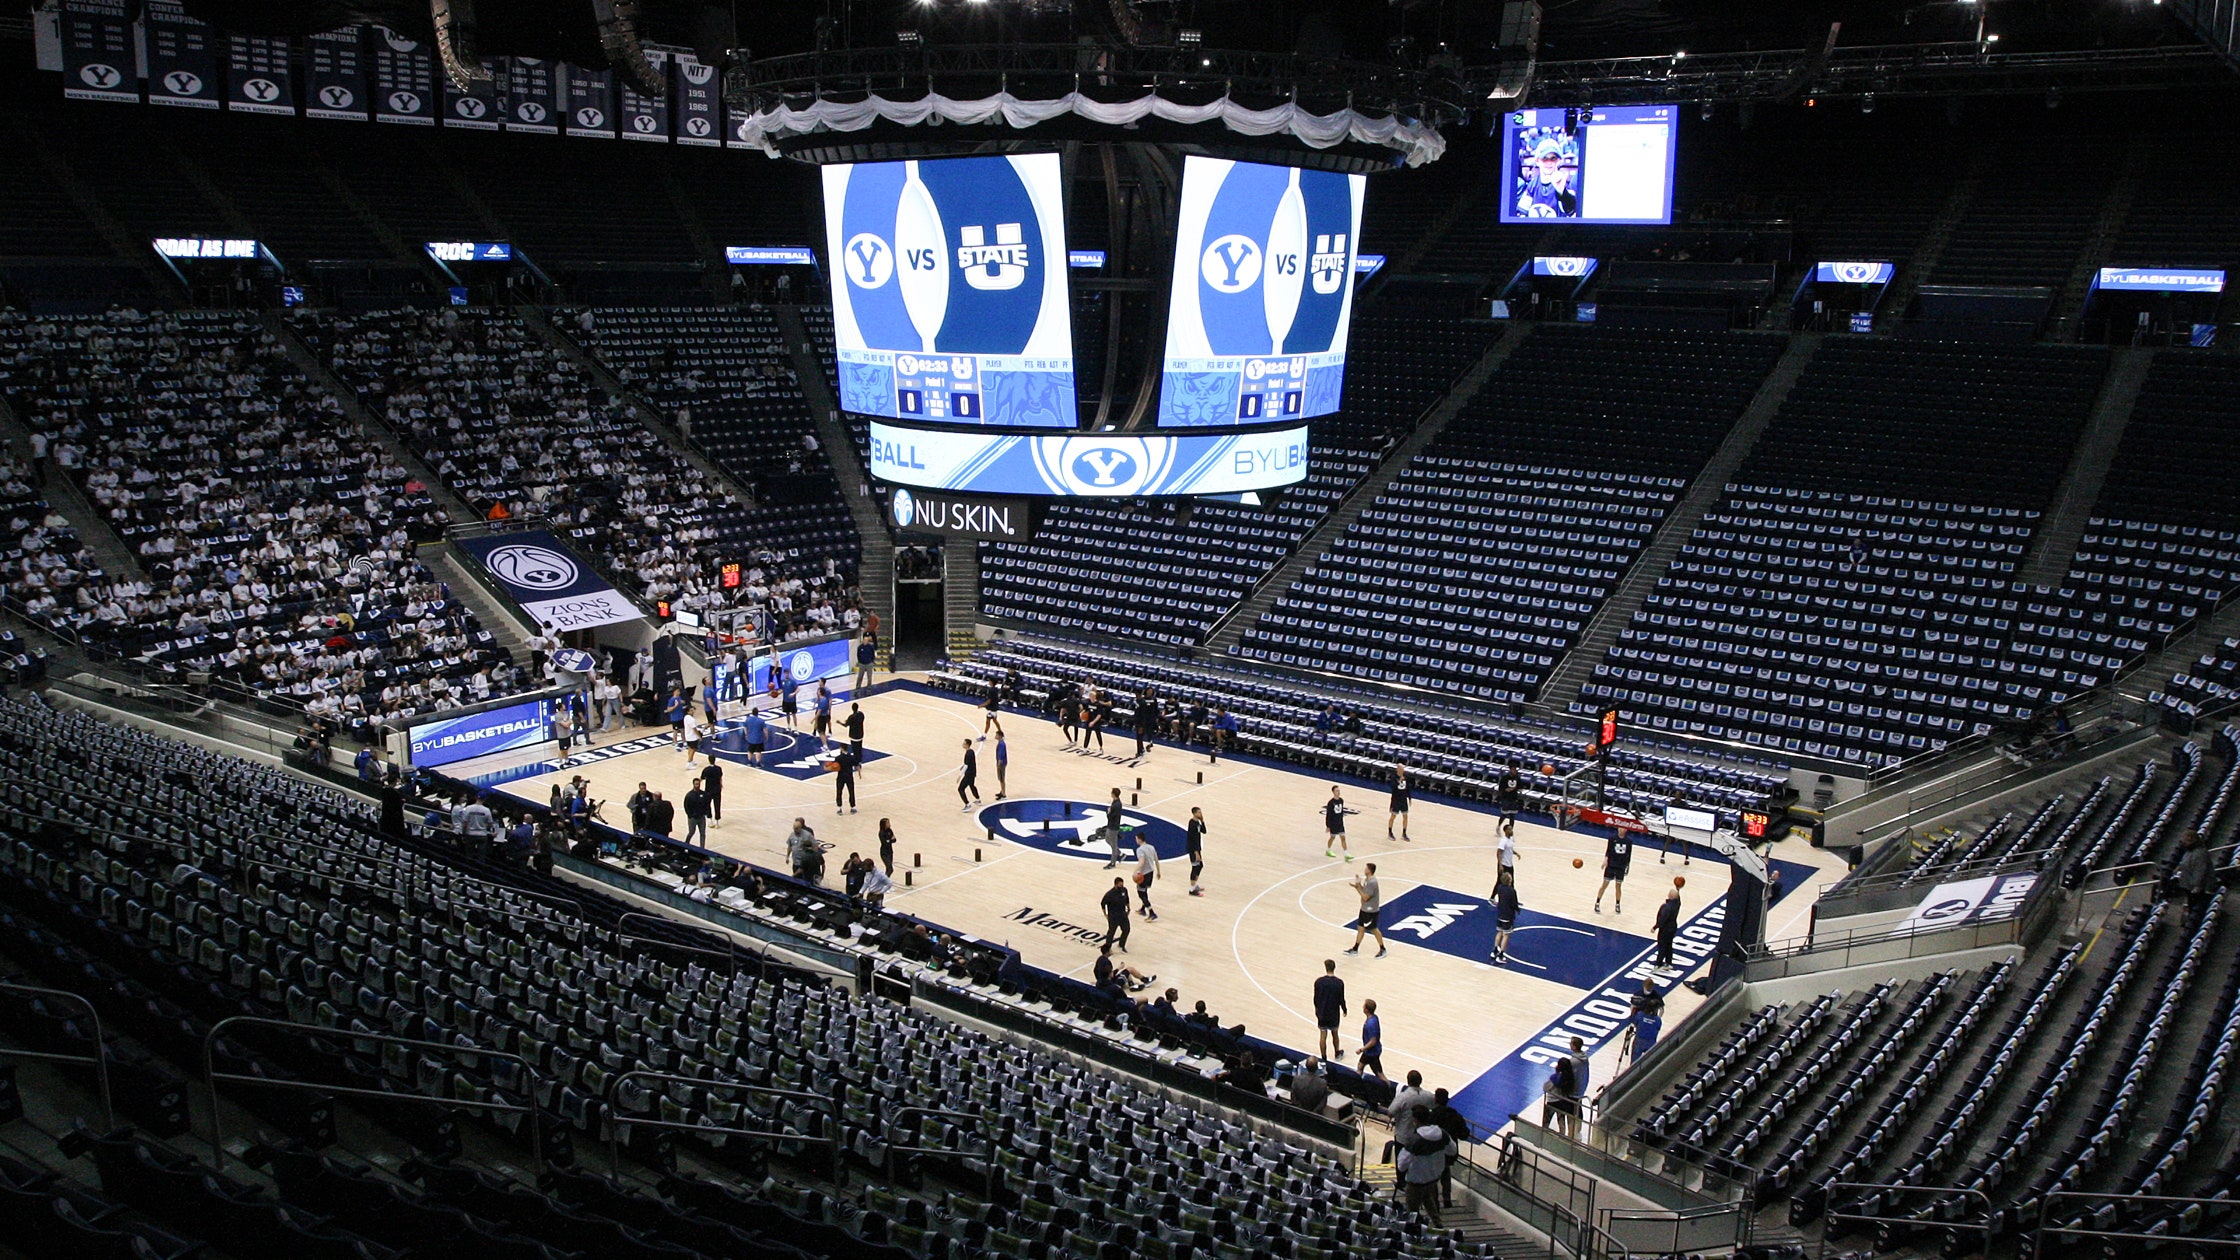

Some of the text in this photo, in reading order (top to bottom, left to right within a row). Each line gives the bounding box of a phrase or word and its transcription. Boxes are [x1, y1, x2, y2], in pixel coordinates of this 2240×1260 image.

[687, 65, 707, 77] NIT
[688, 89, 706, 98] 1951
[200, 239, 223, 257] AS
[224, 239, 255, 257] ONE
[434, 242, 475, 260] ROC
[958, 244, 1029, 269] STATE
[852, 240, 935, 282] Y VS
[1214, 242, 1297, 286] Y VS
[1311, 253, 1346, 274] STATE
[2102, 275, 2224, 285] BYUBASKETBALL
[906, 392, 915, 412] 0
[960, 395, 969, 415] 0
[1247, 396, 1256, 416] 0
[1288, 394, 1296, 412] 0
[871, 444, 925, 471] TBALL
[1080, 449, 1129, 485] Y
[1234, 442, 1308, 475] BYUBA
[915, 499, 946, 528] NU
[544, 598, 610, 616] ZIONS
[557, 608, 621, 627] BANK
[412, 717, 540, 753] BYUBASKETBALL
[1743, 812, 1767, 825] 62:33
[1748, 823, 1763, 837] 30
